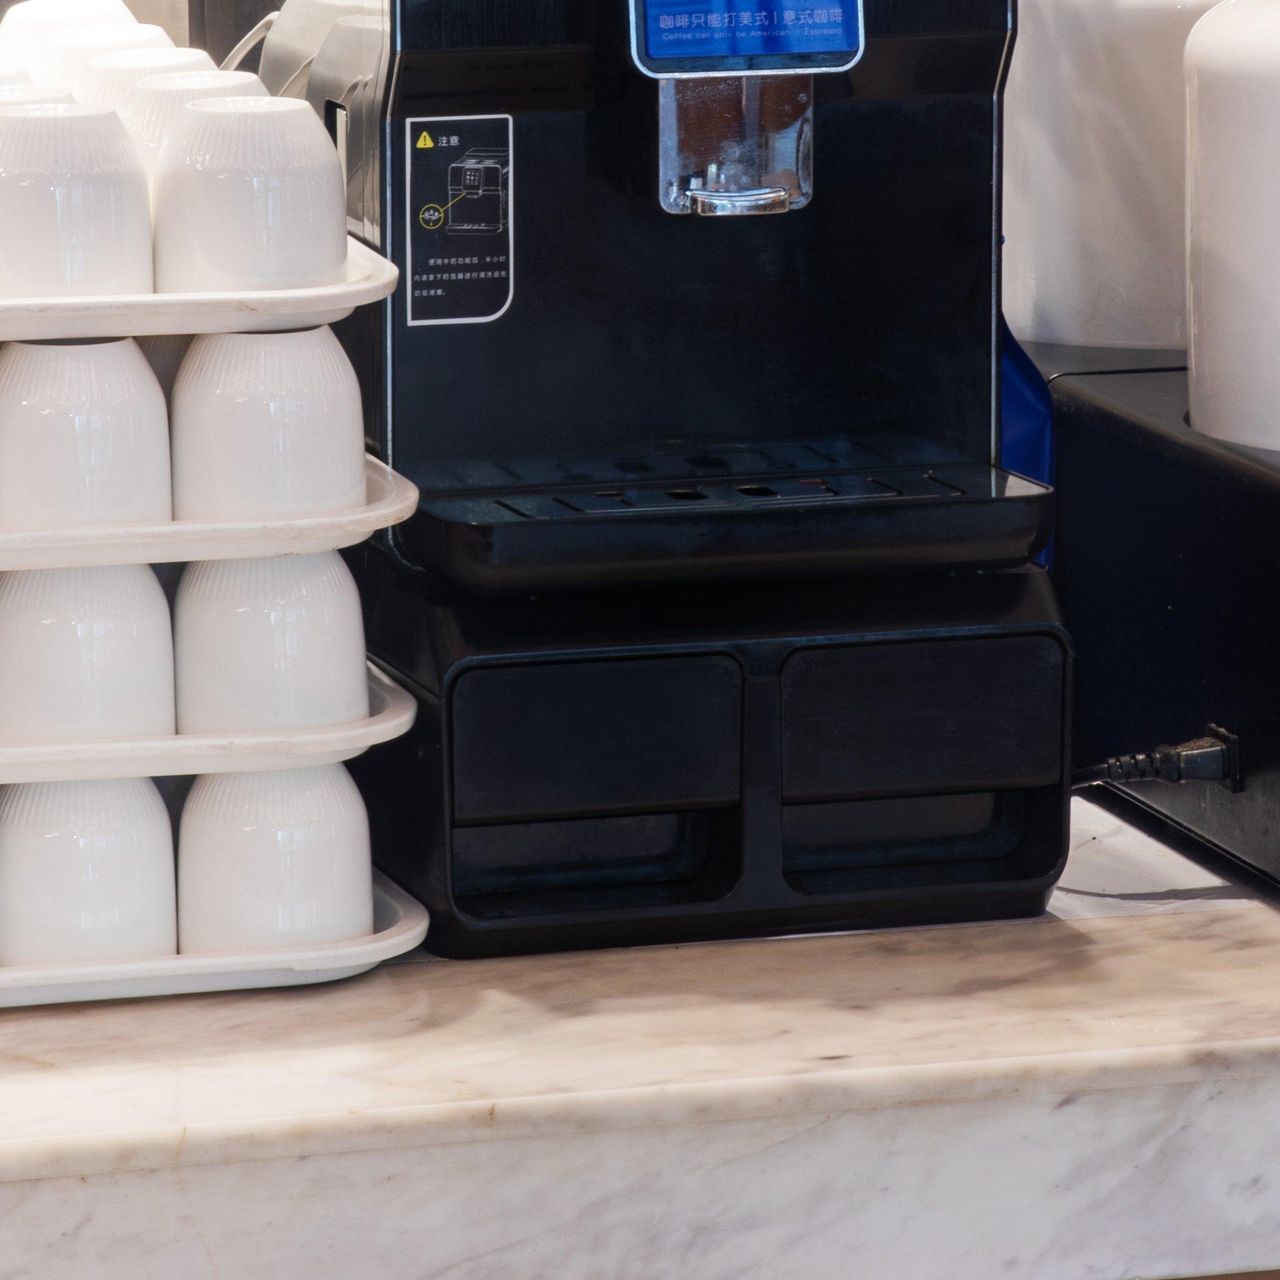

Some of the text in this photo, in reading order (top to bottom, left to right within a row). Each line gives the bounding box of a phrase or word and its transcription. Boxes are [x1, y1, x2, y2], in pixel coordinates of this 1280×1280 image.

[662, 31, 693, 41] Coffee
[695, 31, 711, 40] can
[437, 135, 461, 147] 注意
